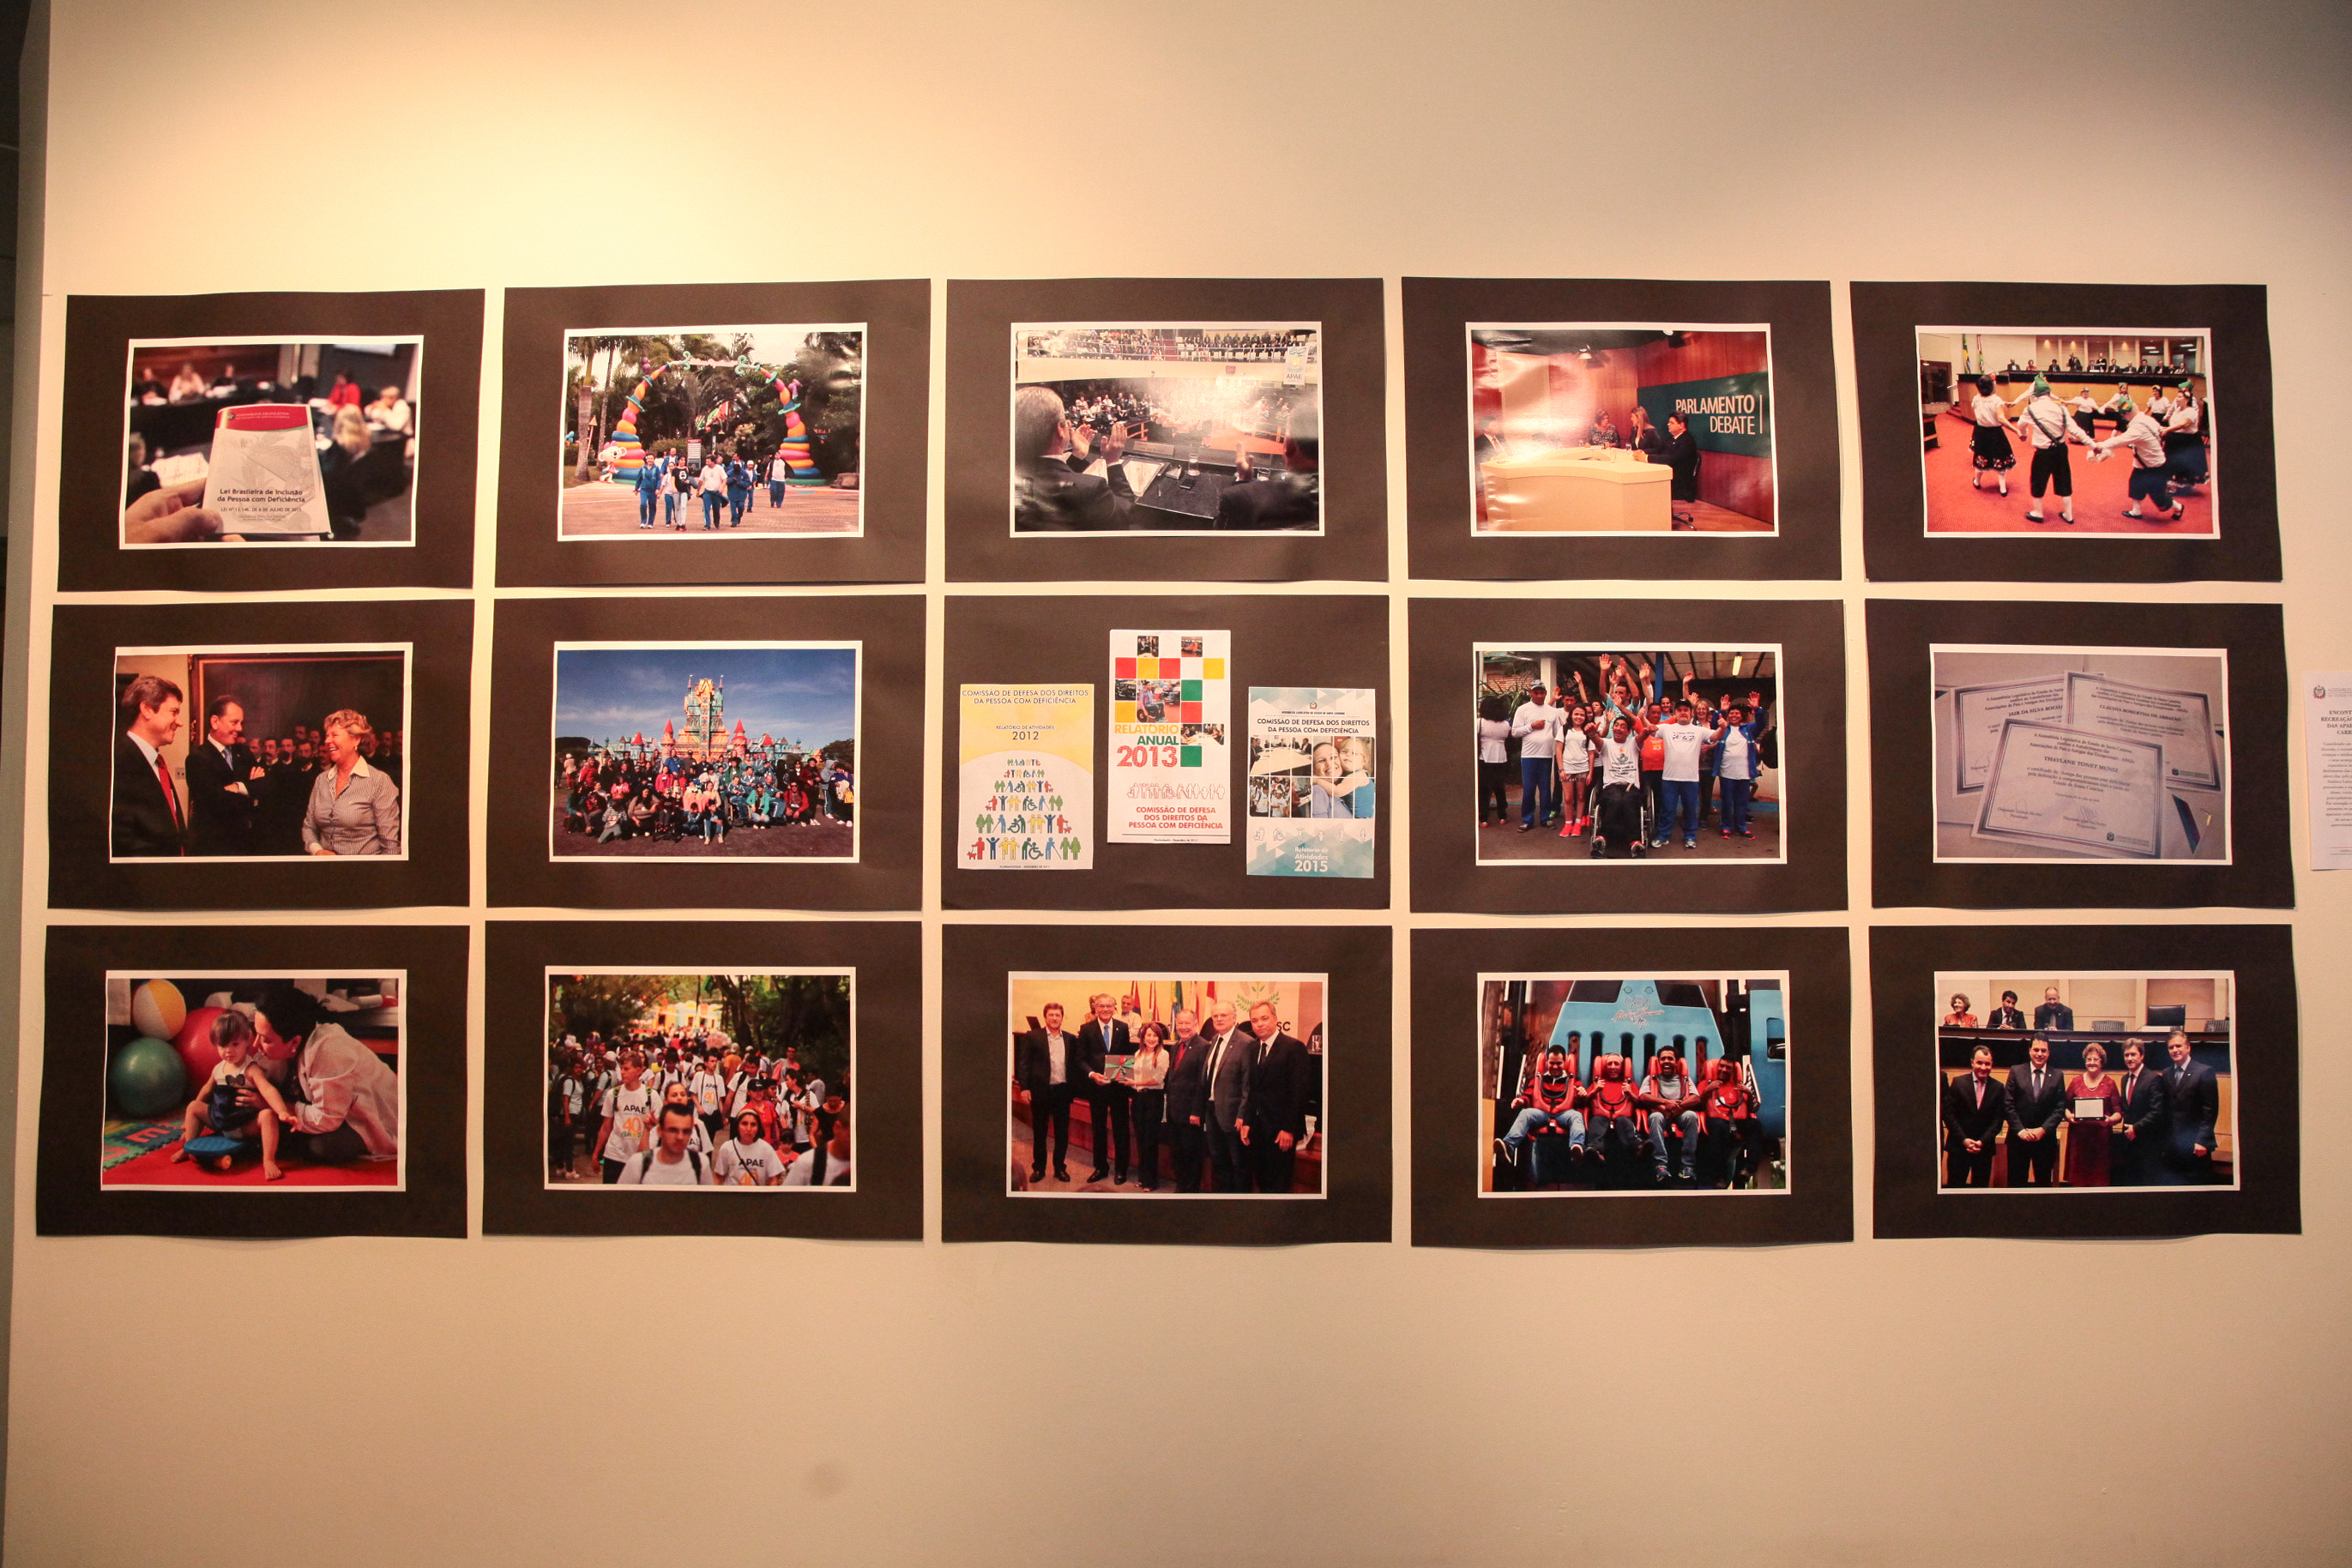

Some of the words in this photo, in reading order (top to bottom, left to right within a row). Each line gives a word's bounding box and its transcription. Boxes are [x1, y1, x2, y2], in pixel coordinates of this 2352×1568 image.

[1675, 395, 1756, 414] PARLAMENTO
[1710, 416, 1756, 435] DEBATE
[1012, 731, 1039, 740] 2012
[1320, 726, 1359, 734] DEFICIÊNCIA
[1137, 735, 1179, 745] ANUAL
[1116, 745, 1178, 768] 2013
[2044, 756, 2076, 766] THAYLANE
[2077, 761, 2098, 769] TONET
[2098, 764, 2119, 773] MUNIZ
[1179, 820, 1223, 829] DEFICIÊNCIA
[1294, 859, 1329, 872] 2015
[1276, 1021, 1291, 1032] SC
[624, 1104, 646, 1114] APAE
[622, 1116, 642, 1133] 40
[739, 1158, 764, 1167] APAE
